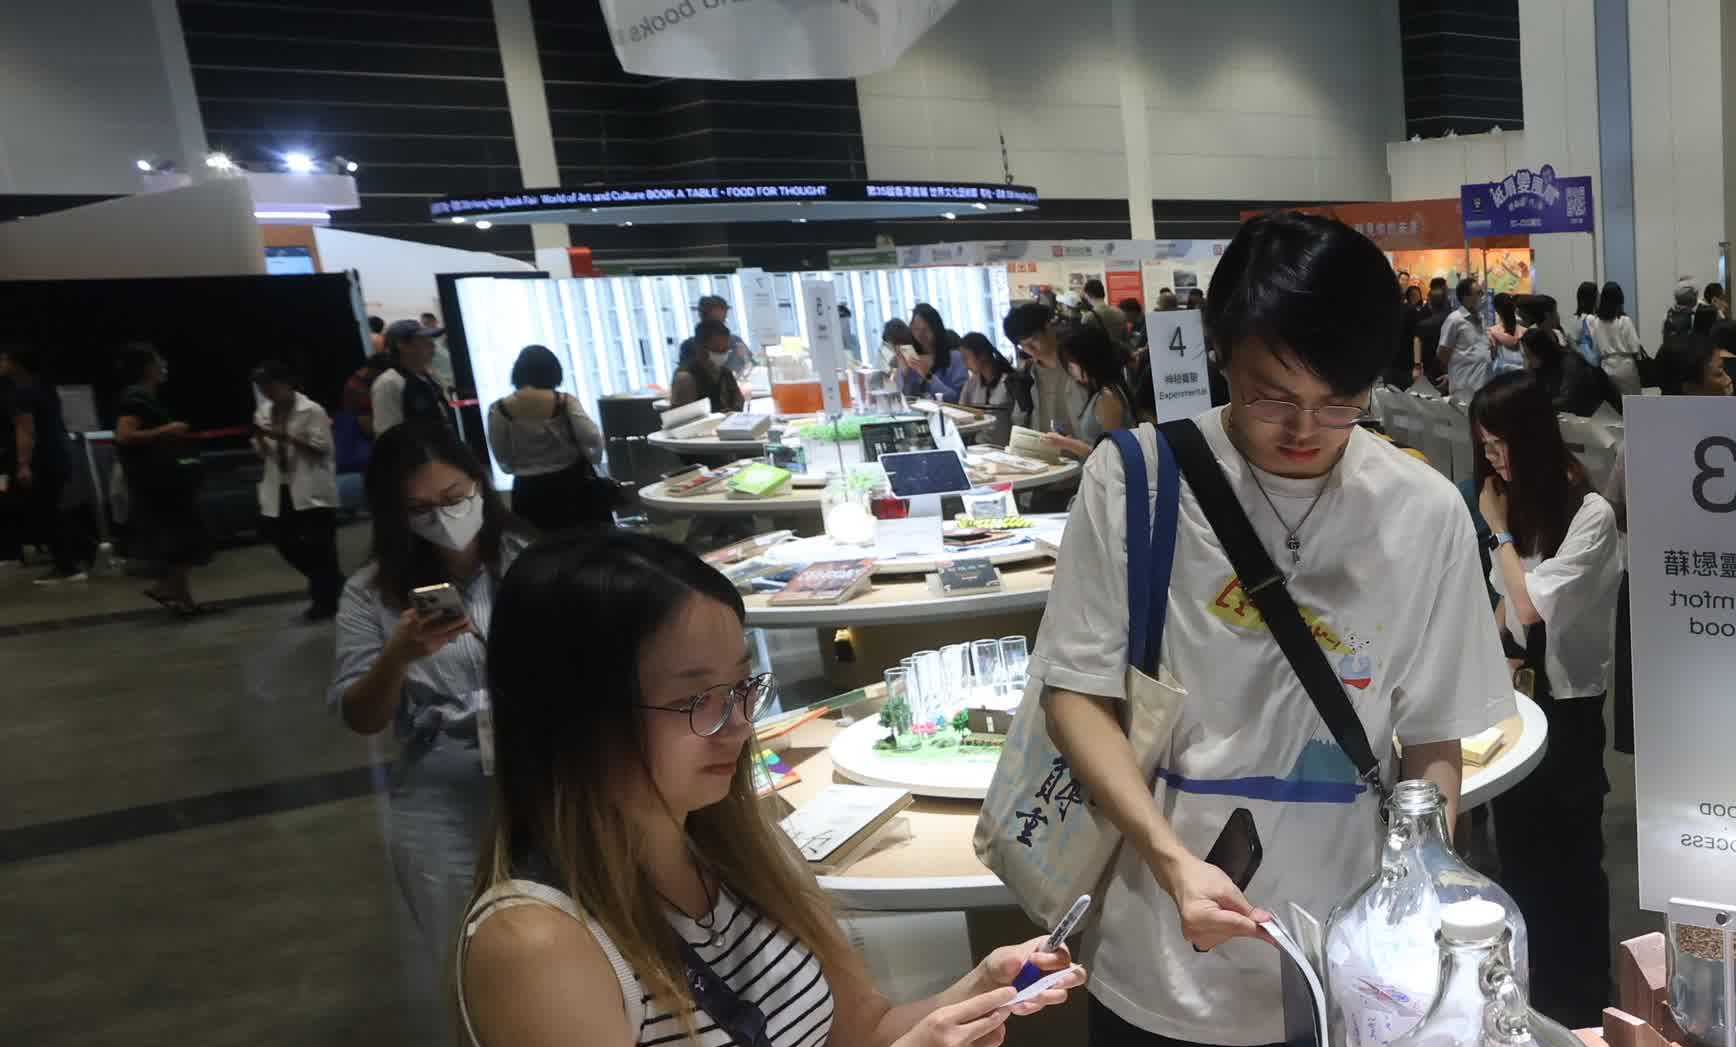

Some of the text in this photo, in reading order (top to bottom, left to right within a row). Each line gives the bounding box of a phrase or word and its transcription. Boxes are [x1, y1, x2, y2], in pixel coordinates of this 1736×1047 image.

[577, 192, 592, 203] Art
[593, 191, 610, 202] and
[611, 190, 646, 201] Culture
[646, 188, 675, 199] BOOK
[676, 188, 685, 198] A
[686, 187, 718, 198] TABLE
[726, 186, 755, 197] FOOD
[756, 186, 778, 196] FOR
[779, 185, 828, 196] THOUGHT
[1169, 326, 1187, 357] 4
